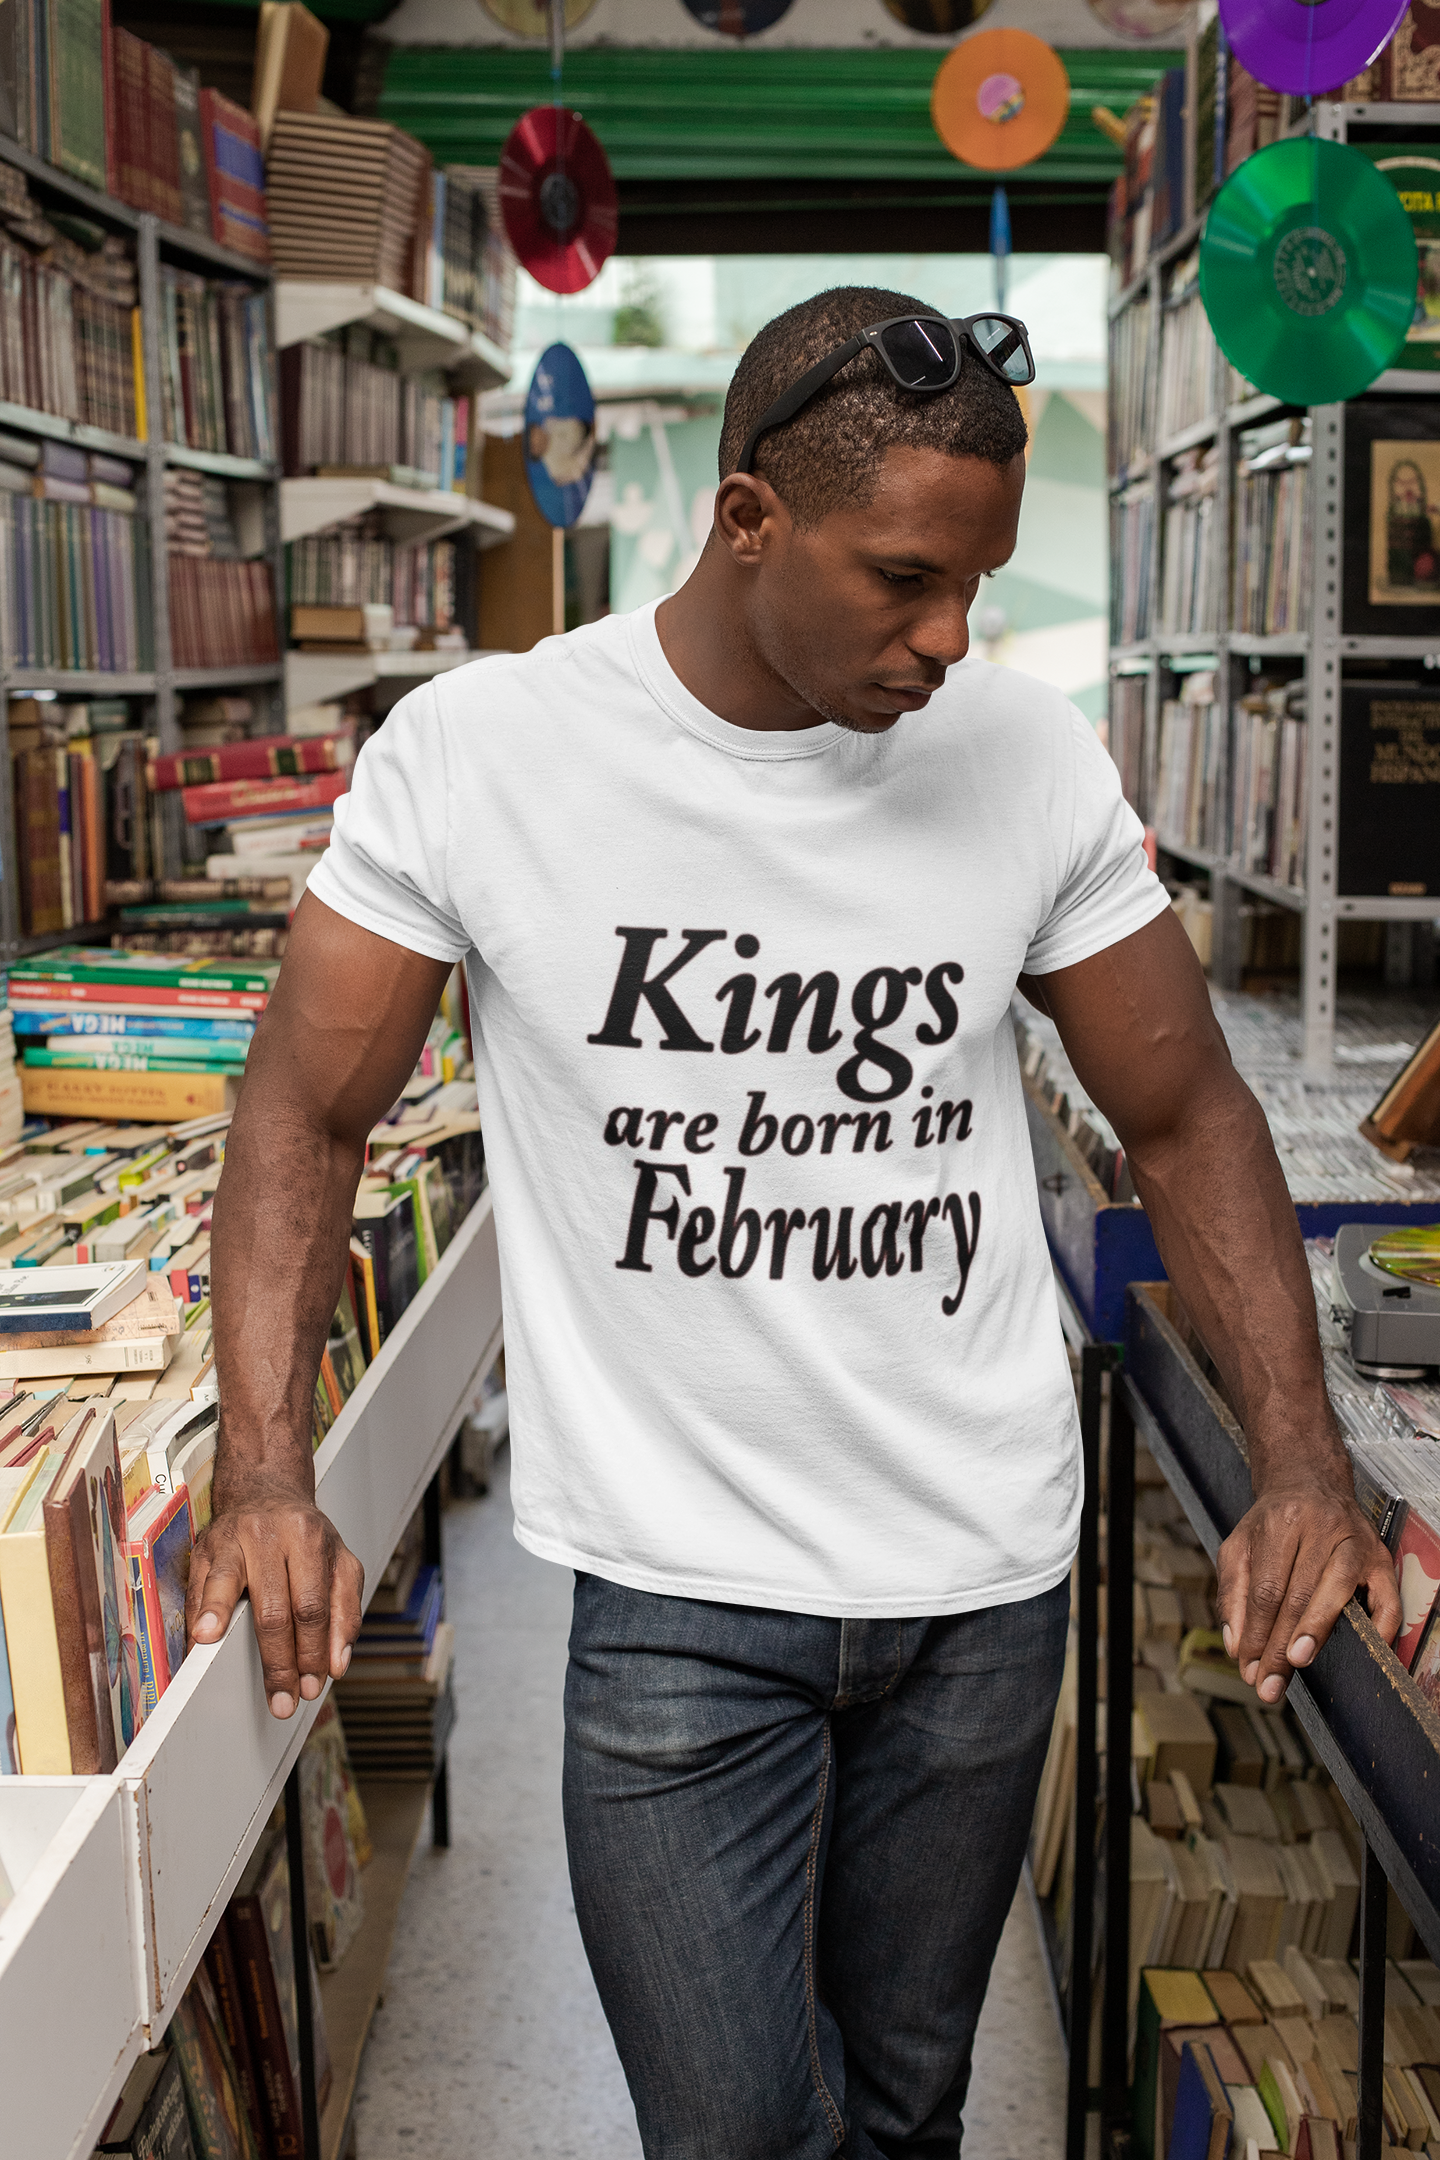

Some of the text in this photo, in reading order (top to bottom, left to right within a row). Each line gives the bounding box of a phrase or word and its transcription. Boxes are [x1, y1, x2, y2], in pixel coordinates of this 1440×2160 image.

[71, 1012, 126, 1034] MEGA
[587, 926, 965, 1103] Kings
[95, 1053, 148, 1071] MEGA
[603, 1085, 973, 1156] are born in
[615, 1159, 981, 1316] February
